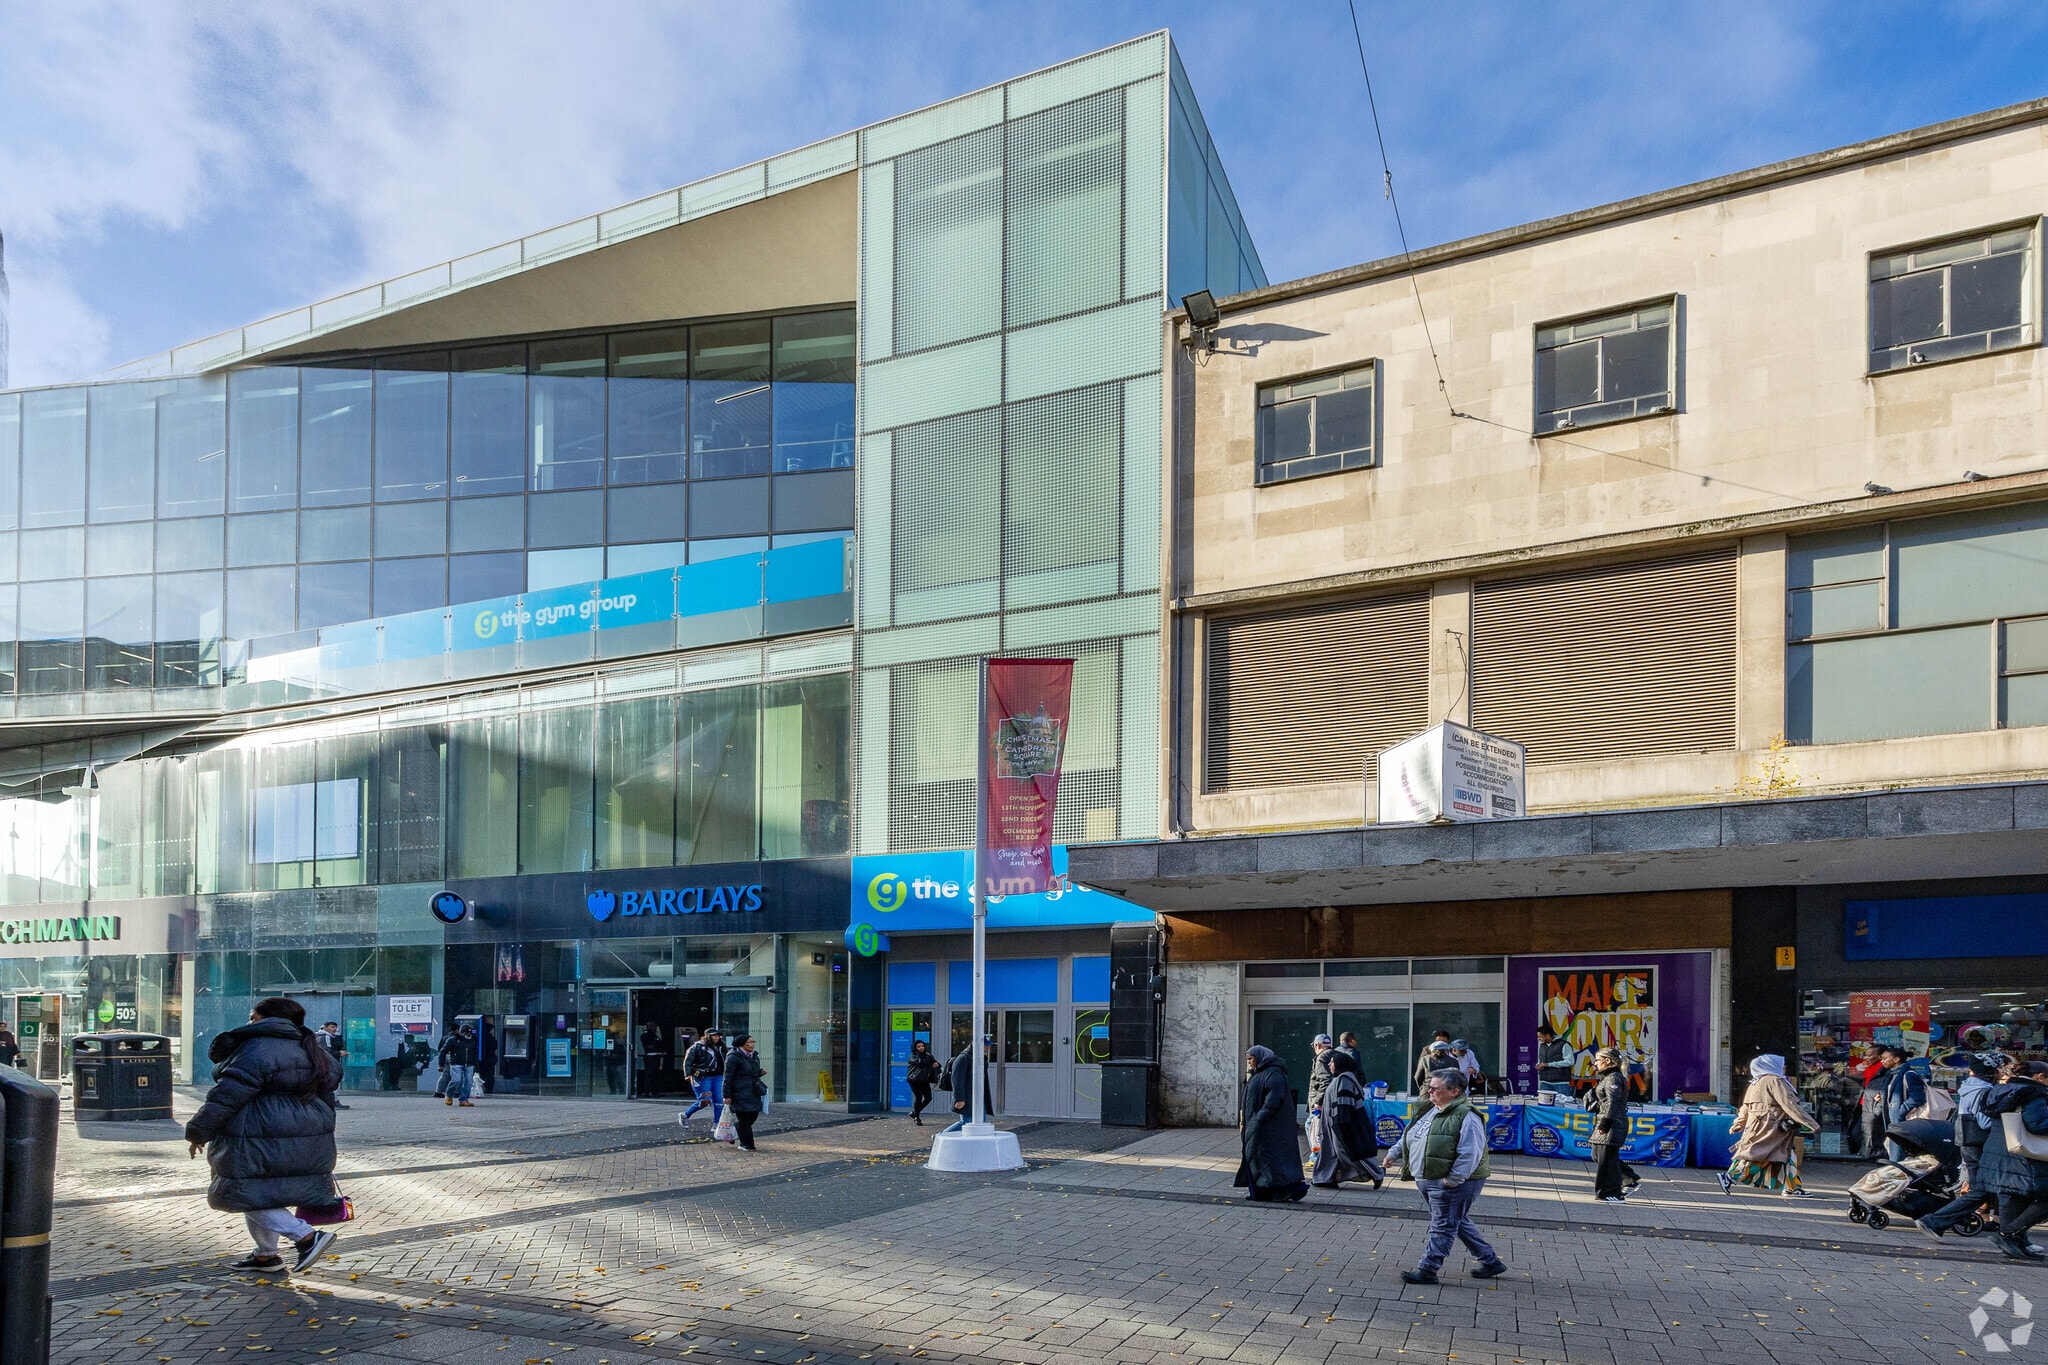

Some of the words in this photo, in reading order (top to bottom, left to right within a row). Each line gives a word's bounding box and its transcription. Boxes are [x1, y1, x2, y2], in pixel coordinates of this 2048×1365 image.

[501, 609, 531, 627] the
[535, 604, 575, 626] gym
[579, 594, 637, 619] group
[1447, 743, 1465, 753] Ground
[1452, 733, 1469, 745] (CAN
[1470, 739, 1480, 748] BE
[1481, 742, 1517, 760] EXTENDED)
[1013, 752, 1041, 760] SQUARE
[1460, 754, 1483, 765] Basement
[1456, 761, 1481, 773] POSSIBLE
[1481, 768, 1496, 777] FIRST
[1496, 772, 1513, 782] FLOOR
[1463, 770, 1508, 787] ACCOMMODATION
[1477, 782, 1504, 794] ENQUIRIES
[1462, 790, 1482, 804] BWD
[1010, 857, 1026, 867] and
[911, 876, 960, 899] the
[620, 884, 763, 917] BARCLAYS
[1547, 972, 1649, 1011] MAKE
[392, 1004, 404, 1012] TO
[405, 1004, 422, 1012] LET
[1865, 999, 1874, 1008] 3
[1876, 998, 1897, 1008] for
[1900, 999, 1912, 1008] £1
[116, 1007, 137, 1020] 50%
[1551, 1013, 1643, 1051] YOUR
[1556, 1112, 1656, 1135] JES
